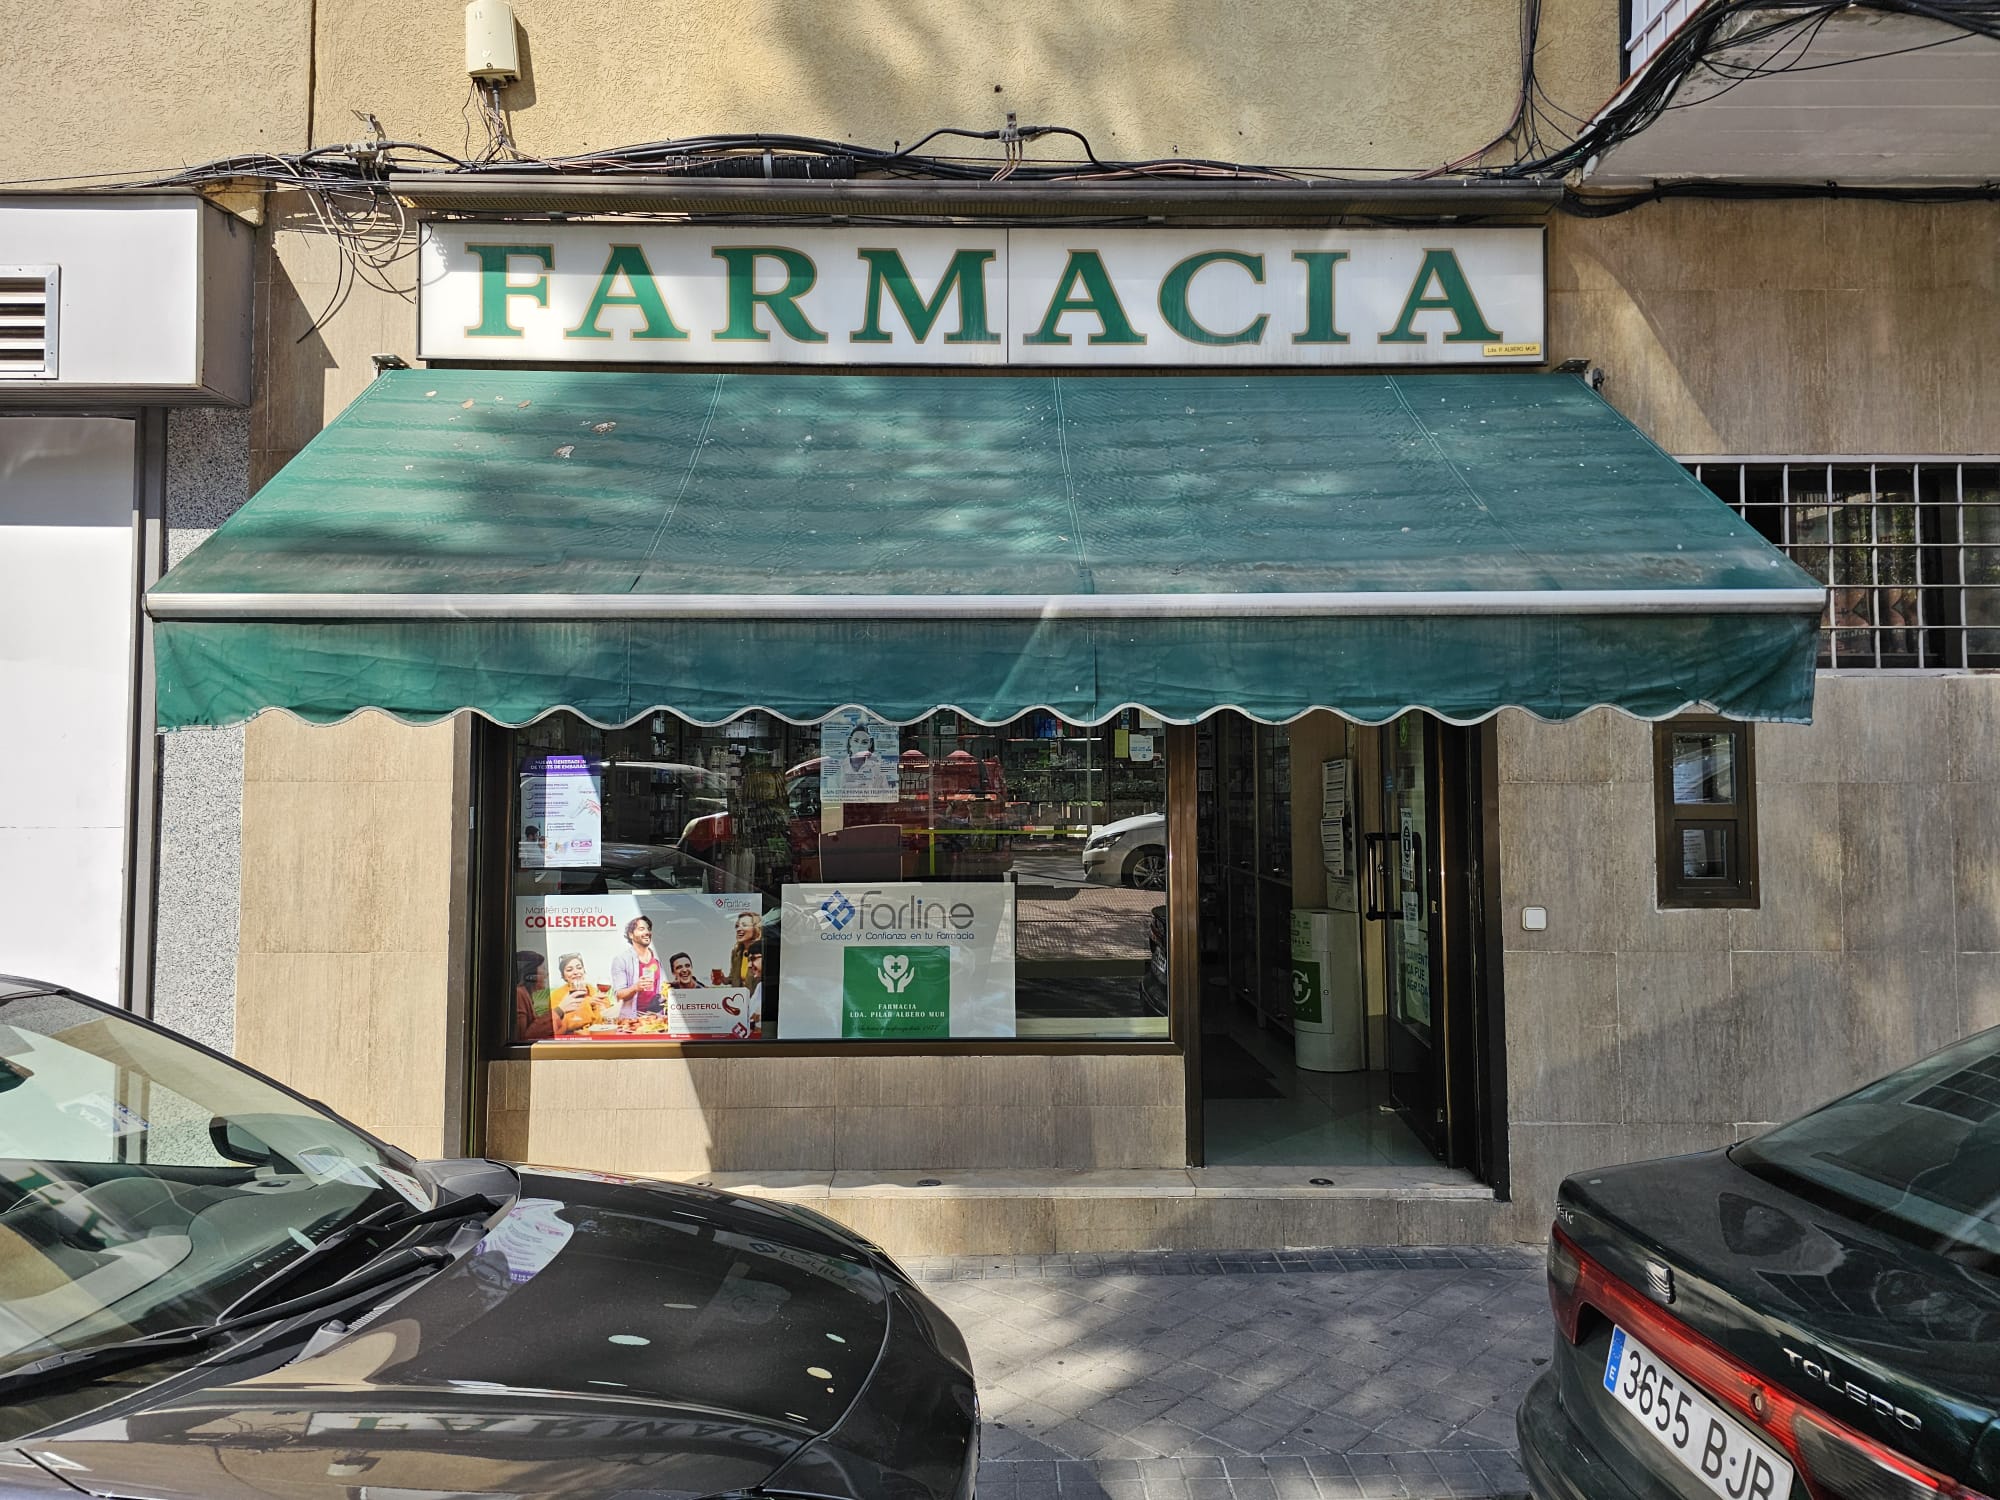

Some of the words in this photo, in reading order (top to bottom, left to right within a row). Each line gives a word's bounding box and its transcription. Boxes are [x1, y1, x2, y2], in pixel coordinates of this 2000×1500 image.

[464, 241, 1504, 345] FARMACIA
[525, 906, 560, 914] Mantén
[570, 907, 593, 916] raya
[594, 906, 603, 914] tu
[860, 890, 975, 930] farline
[524, 915, 617, 928] COLESTEROL
[820, 932, 852, 941] Calidad
[856, 933, 862, 942] y
[865, 932, 906, 941] Confianza
[924, 932, 933, 940] tu
[936, 932, 975, 940] Farmacia
[670, 1003, 722, 1011] COLESTEROL
[1608, 1364, 1617, 1382] E
[1783, 1347, 1923, 1433] TOLEDO
[1623, 1350, 1693, 1449] 3655
[1701, 1417, 1775, 1500] BJR
